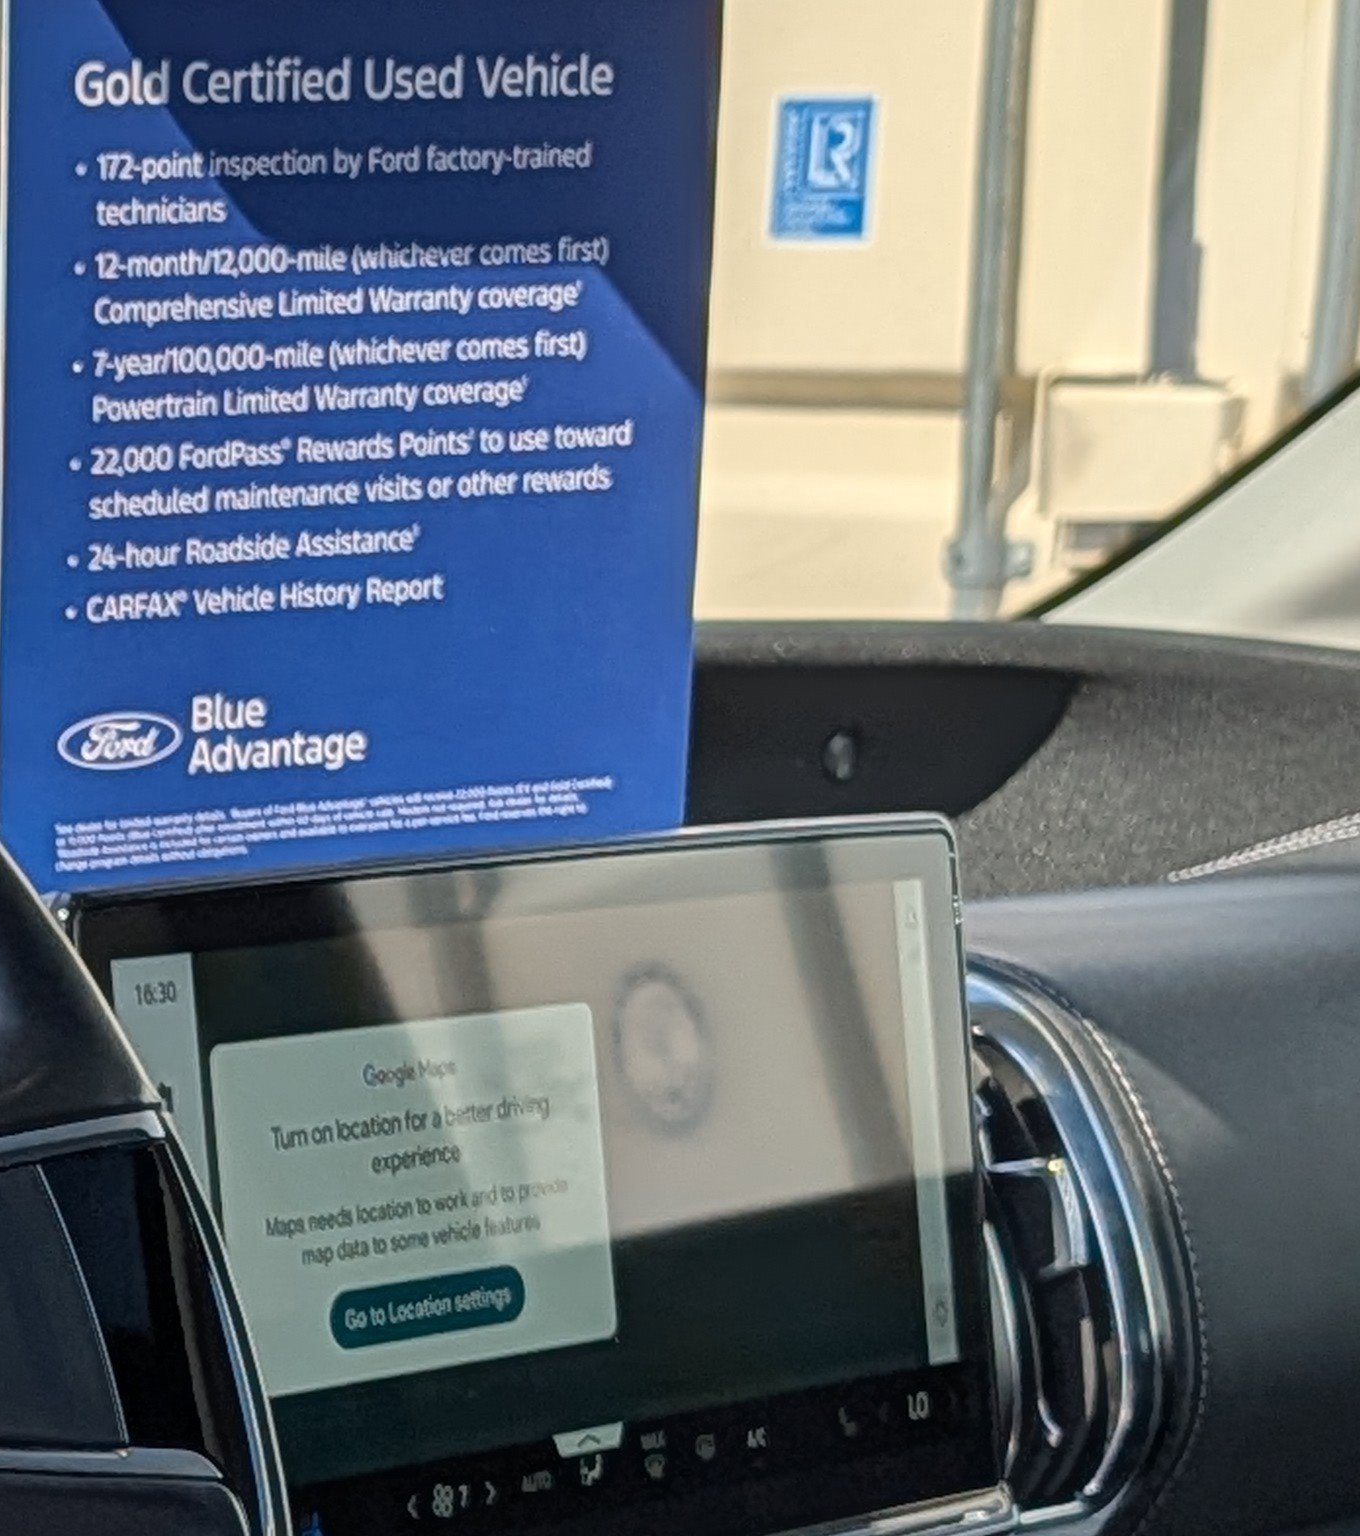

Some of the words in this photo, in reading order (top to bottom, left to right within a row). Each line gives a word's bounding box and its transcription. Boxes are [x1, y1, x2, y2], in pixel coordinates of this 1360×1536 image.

[74, 57, 170, 107] Gold
[182, 54, 353, 104] Certified
[364, 53, 465, 101] Used
[476, 52, 615, 98] Vehicle
[96, 150, 204, 184] 172-point
[209, 149, 327, 180] inspection
[334, 146, 363, 179] by
[368, 144, 421, 174] Ford
[426, 139, 594, 175] factory-trained
[95, 195, 227, 226] technicians
[94, 243, 347, 279] 12-month/12,000-mile
[351, 240, 475, 275] (whichever
[479, 242, 551, 266] comes
[558, 235, 610, 266] first)
[93, 291, 274, 327] Comprehensive
[278, 286, 363, 317] Limited
[368, 283, 473, 315] Warranty
[92, 339, 323, 382] 7-year/100,000-mile
[329, 335, 451, 372] (whichever
[455, 337, 529, 361] comes
[534, 329, 587, 361] first)
[92, 389, 218, 423] Powertrain
[223, 385, 310, 416] Limited
[314, 382, 418, 412] Warranty
[90, 445, 172, 477] 22,000
[296, 432, 394, 463] Rewards
[479, 427, 504, 453] to
[509, 427, 549, 451] use
[554, 418, 633, 450] toward
[88, 485, 211, 519] scheduled
[214, 480, 360, 511] maintenance
[365, 473, 422, 502] visits
[427, 475, 453, 499] or
[457, 469, 518, 498] other
[522, 462, 612, 493] rewards
[87, 541, 180, 571] 24-hour
[185, 532, 291, 565] Roadside
[192, 583, 276, 615] Vehicle
[279, 581, 361, 611] History
[366, 572, 445, 606] Report
[190, 693, 266, 733] Blue
[80, 721, 160, 761] Ford
[187, 731, 367, 775] Advantage
[135, 980, 177, 1006] 16:30
[362, 1061, 416, 1088] Google
[417, 1058, 457, 1081] Maps
[271, 1124, 309, 1151] Turn
[311, 1123, 334, 1145] on
[336, 1113, 402, 1142] location
[404, 1108, 428, 1132] for
[431, 1111, 443, 1129] a
[445, 1103, 493, 1126] better
[496, 1095, 551, 1121] driving
[370, 1141, 462, 1176] experience
[265, 1216, 306, 1240] Maps
[308, 1208, 354, 1232] needs
[356, 1199, 414, 1224] location
[416, 1195, 432, 1216] to
[434, 1189, 469, 1212] work
[471, 1184, 497, 1207] and
[500, 1183, 516, 1202] to
[518, 1177, 569, 1204] provide
[301, 1245, 335, 1266] map
[337, 1236, 370, 1260] data
[372, 1235, 388, 1255] to
[390, 1232, 430, 1253] some
[431, 1220, 481, 1246] vehicle
[483, 1211, 541, 1238] features
[345, 1306, 368, 1331] Go
[370, 1305, 386, 1327] to
[388, 1293, 452, 1324] Location
[454, 1285, 512, 1314] settings
